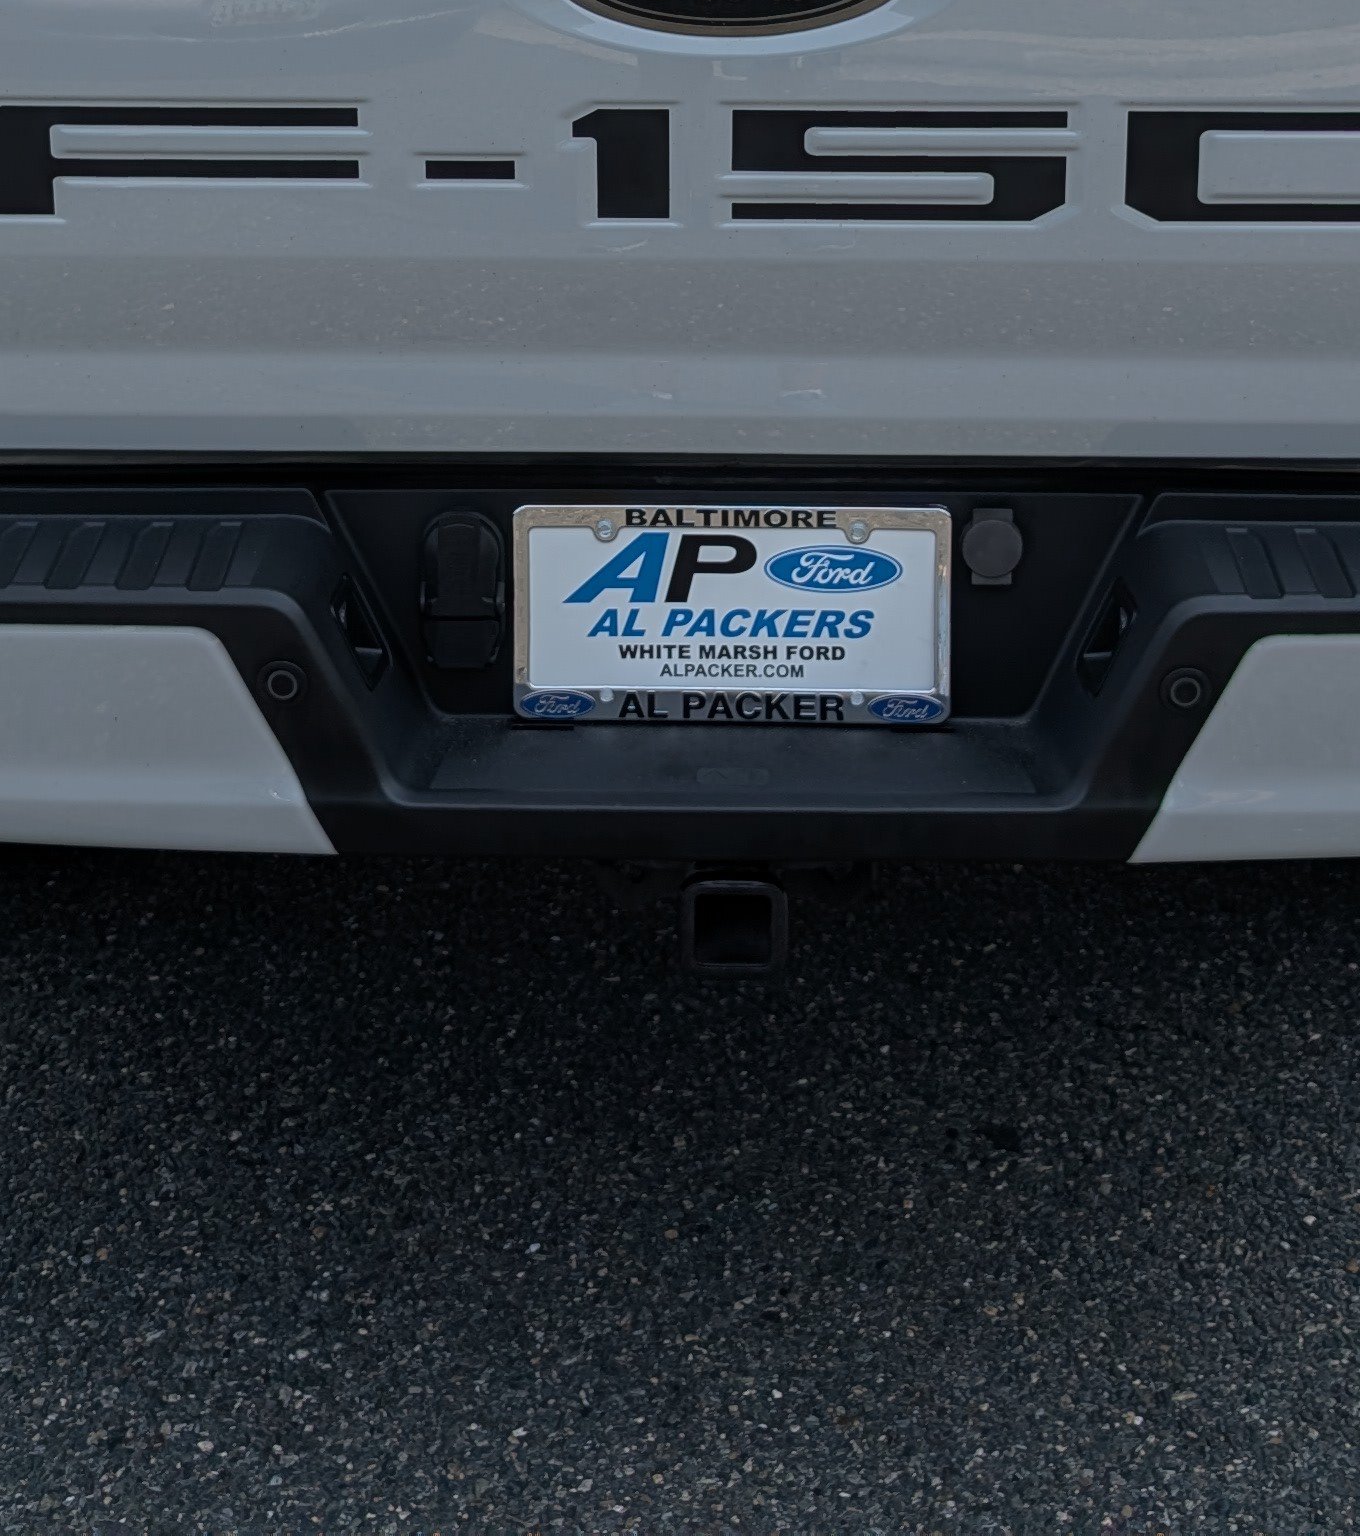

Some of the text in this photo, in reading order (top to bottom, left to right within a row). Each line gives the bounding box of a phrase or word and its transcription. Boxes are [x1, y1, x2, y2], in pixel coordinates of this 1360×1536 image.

[625, 508, 838, 529] BALTIMORE
[562, 531, 758, 603] AP
[790, 551, 876, 585] Ford
[586, 608, 876, 640] AL PACKERS
[618, 643, 846, 661] WHITE MARSH FORD
[659, 663, 805, 678] ALPACKER.COM
[533, 694, 581, 715] Ford
[618, 689, 844, 721] AL PACKER
[882, 698, 930, 720] Ford
